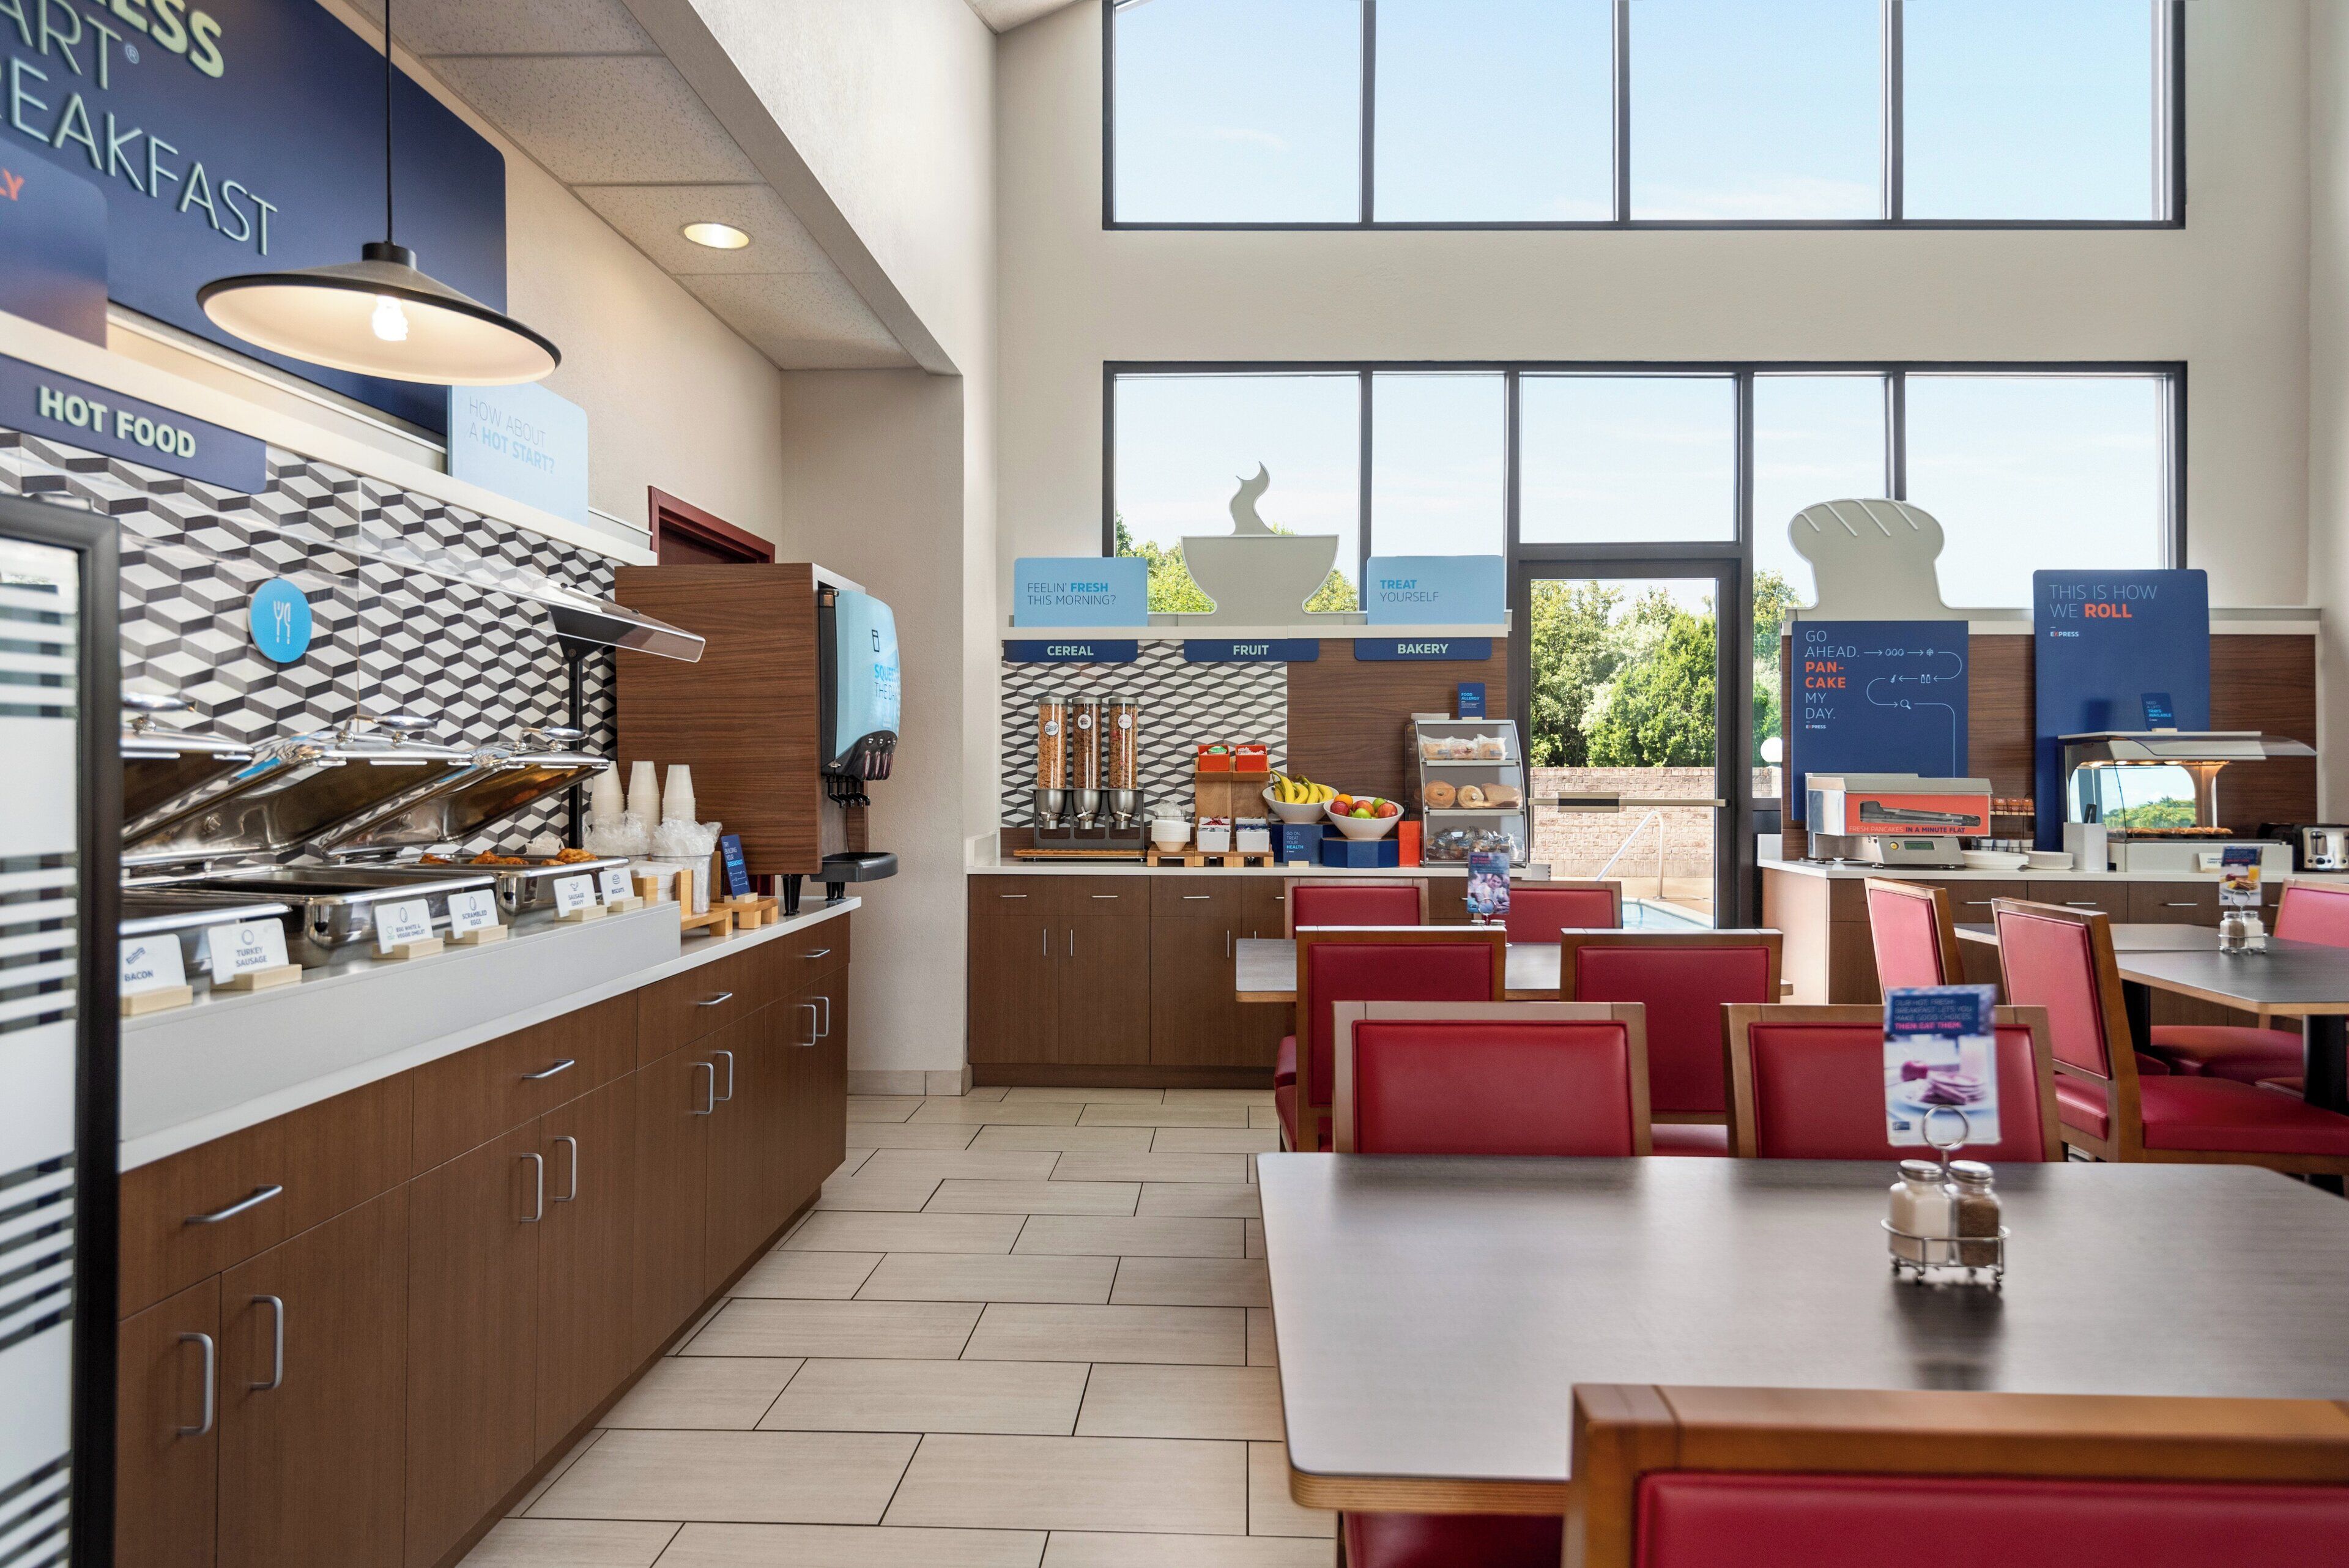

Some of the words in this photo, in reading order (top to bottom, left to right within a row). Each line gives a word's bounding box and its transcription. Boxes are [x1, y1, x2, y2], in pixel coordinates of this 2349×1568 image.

[0, 57, 278, 256] EAKFAST
[40, 385, 108, 433] HOT
[116, 409, 196, 458] FOOD
[469, 396, 502, 427] HOW
[506, 416, 546, 448] ABOUT
[469, 422, 478, 441] A
[482, 426, 508, 453] HOT
[513, 441, 555, 474] START?
[1027, 582, 1067, 593] FEELIN'
[1071, 582, 1108, 592] FRESH
[1380, 579, 1417, 589] TREAT
[1380, 592, 1439, 602] YOURSELF
[2049, 585, 2087, 600] THIS
[2093, 585, 2107, 600] IS
[2113, 585, 2158, 600] HOW
[1028, 595, 1052, 605] THIS
[1056, 595, 1116, 605] MORNING?
[2049, 603, 2078, 618] WE
[2084, 603, 2132, 619] ROLL
[1806, 630, 1827, 642] GO
[1047, 645, 1094, 656] CEREAL
[1233, 645, 1269, 656] FRUIT
[1398, 644, 1449, 654] BAKERY
[1805, 646, 1860, 658] AHEAD.
[1805, 661, 1844, 673] PAN-
[1805, 677, 1846, 688] CAKE
[1806, 693, 1827, 704] MY
[1805, 708, 1836, 719] DAY.
[462, 910, 488, 920] SCRAMBLED
[236, 946, 264, 957] TURKEY
[236, 954, 267, 967] SAUSAGE
[124, 970, 154, 982] BACON
